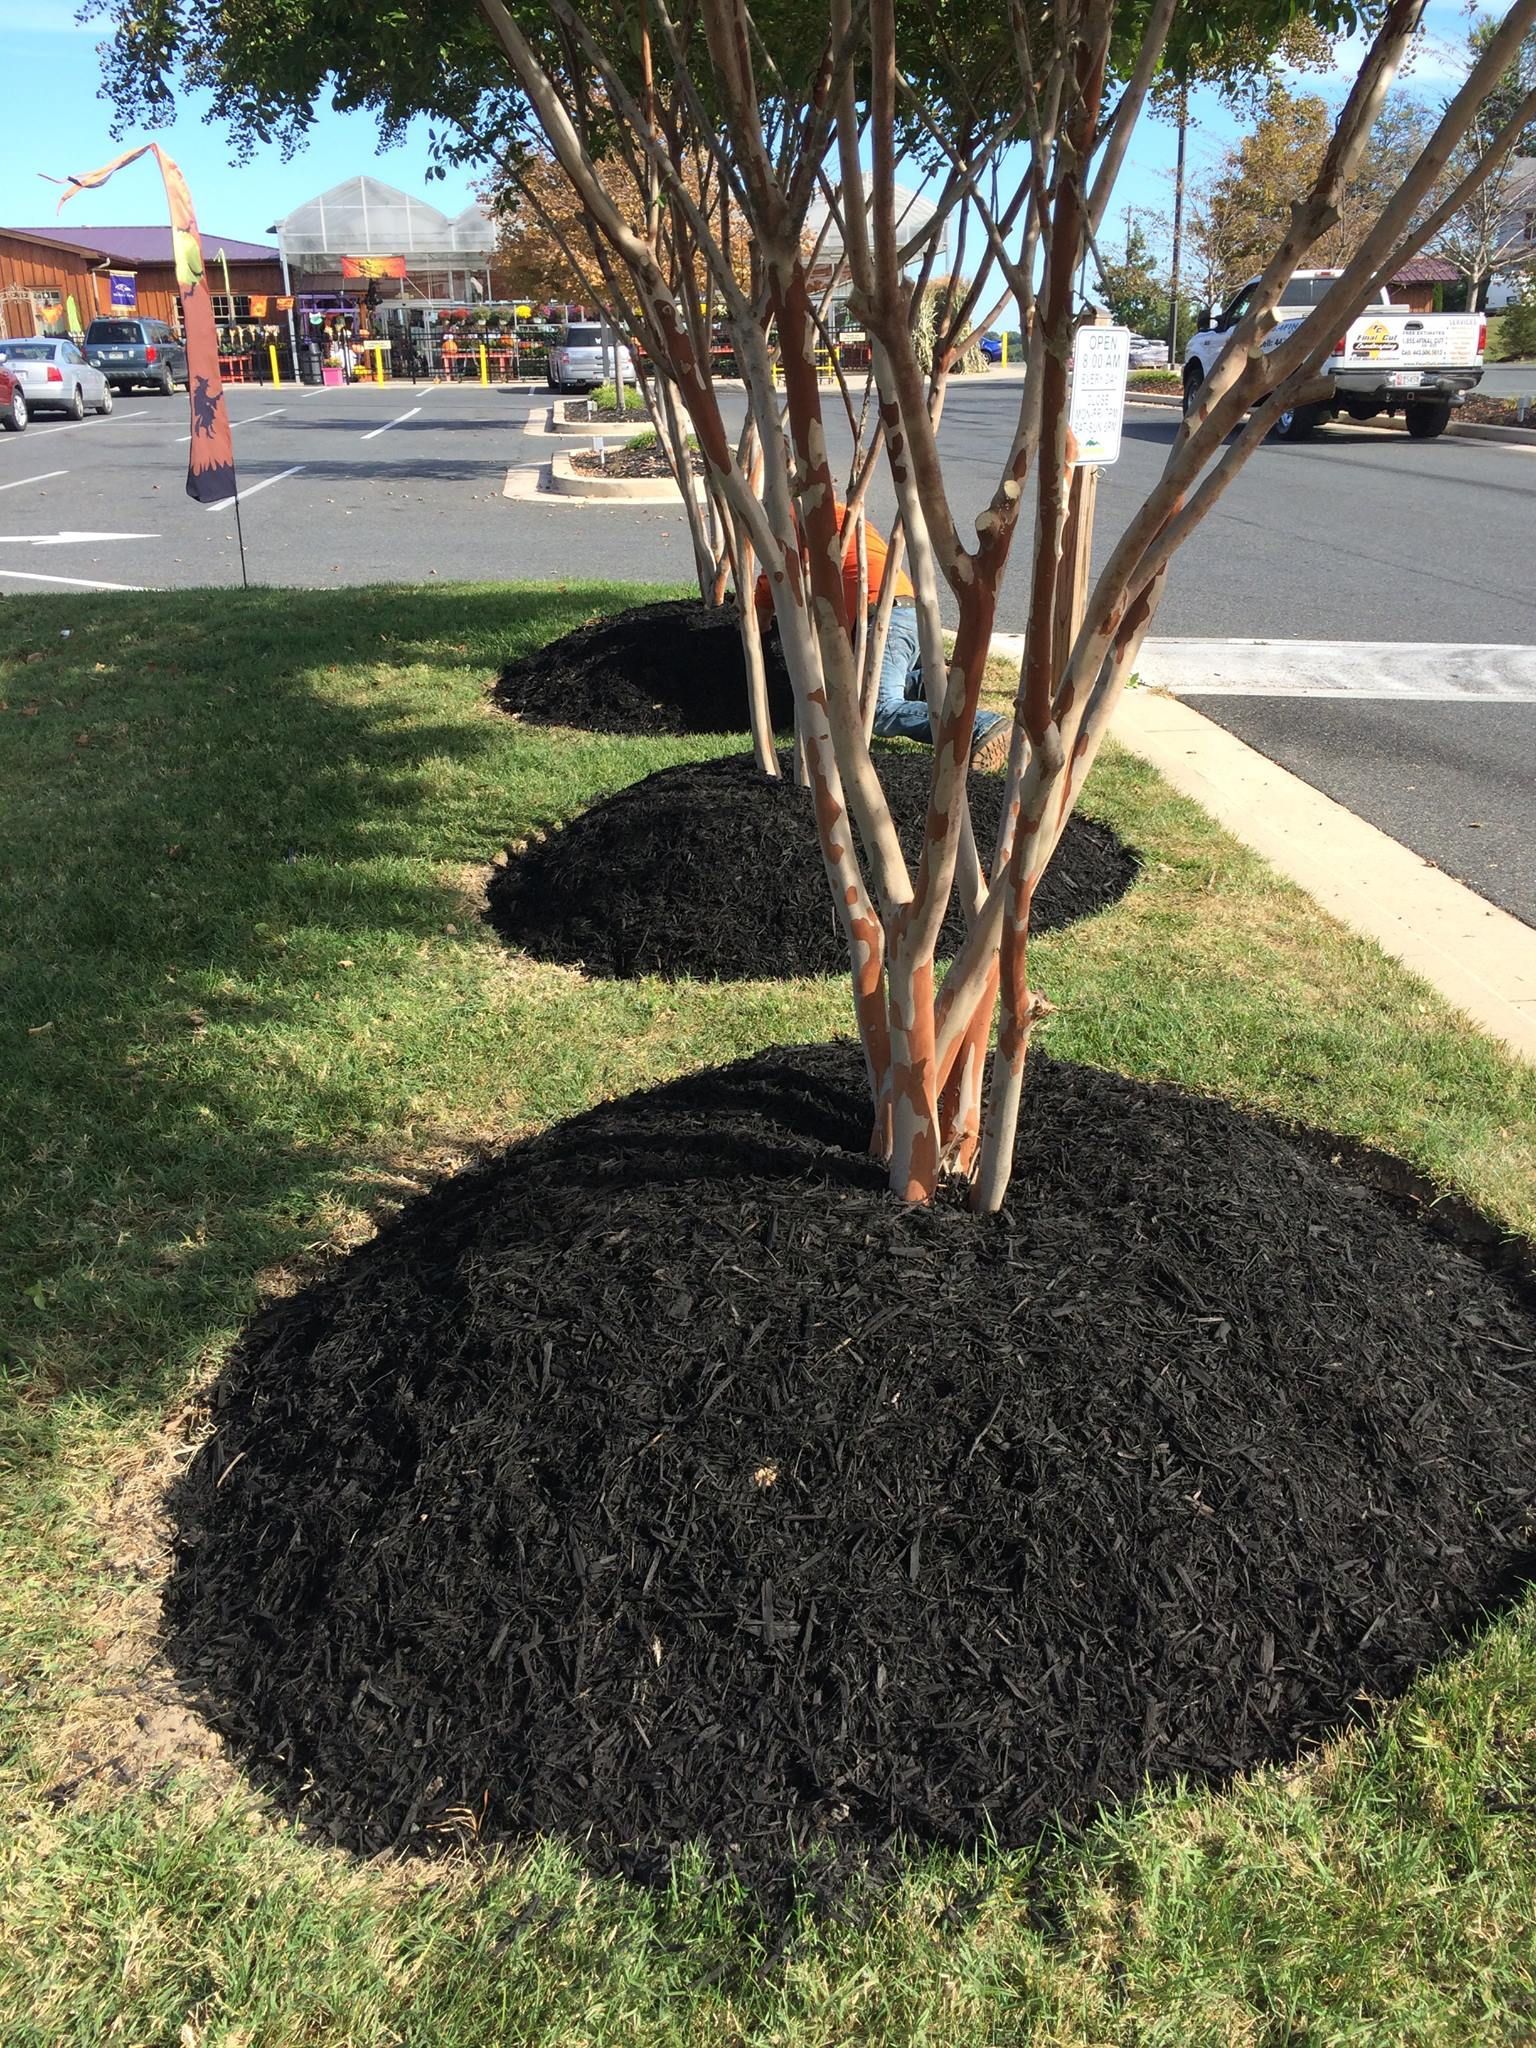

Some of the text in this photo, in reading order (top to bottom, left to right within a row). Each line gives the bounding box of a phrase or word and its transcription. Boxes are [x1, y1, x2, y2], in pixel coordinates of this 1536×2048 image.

[1088, 335, 1118, 351] OPEN
[1105, 353, 1121, 369] AM
[1081, 372, 1118, 385] EVERY DAY
[1088, 394, 1109, 406] CLOSE
